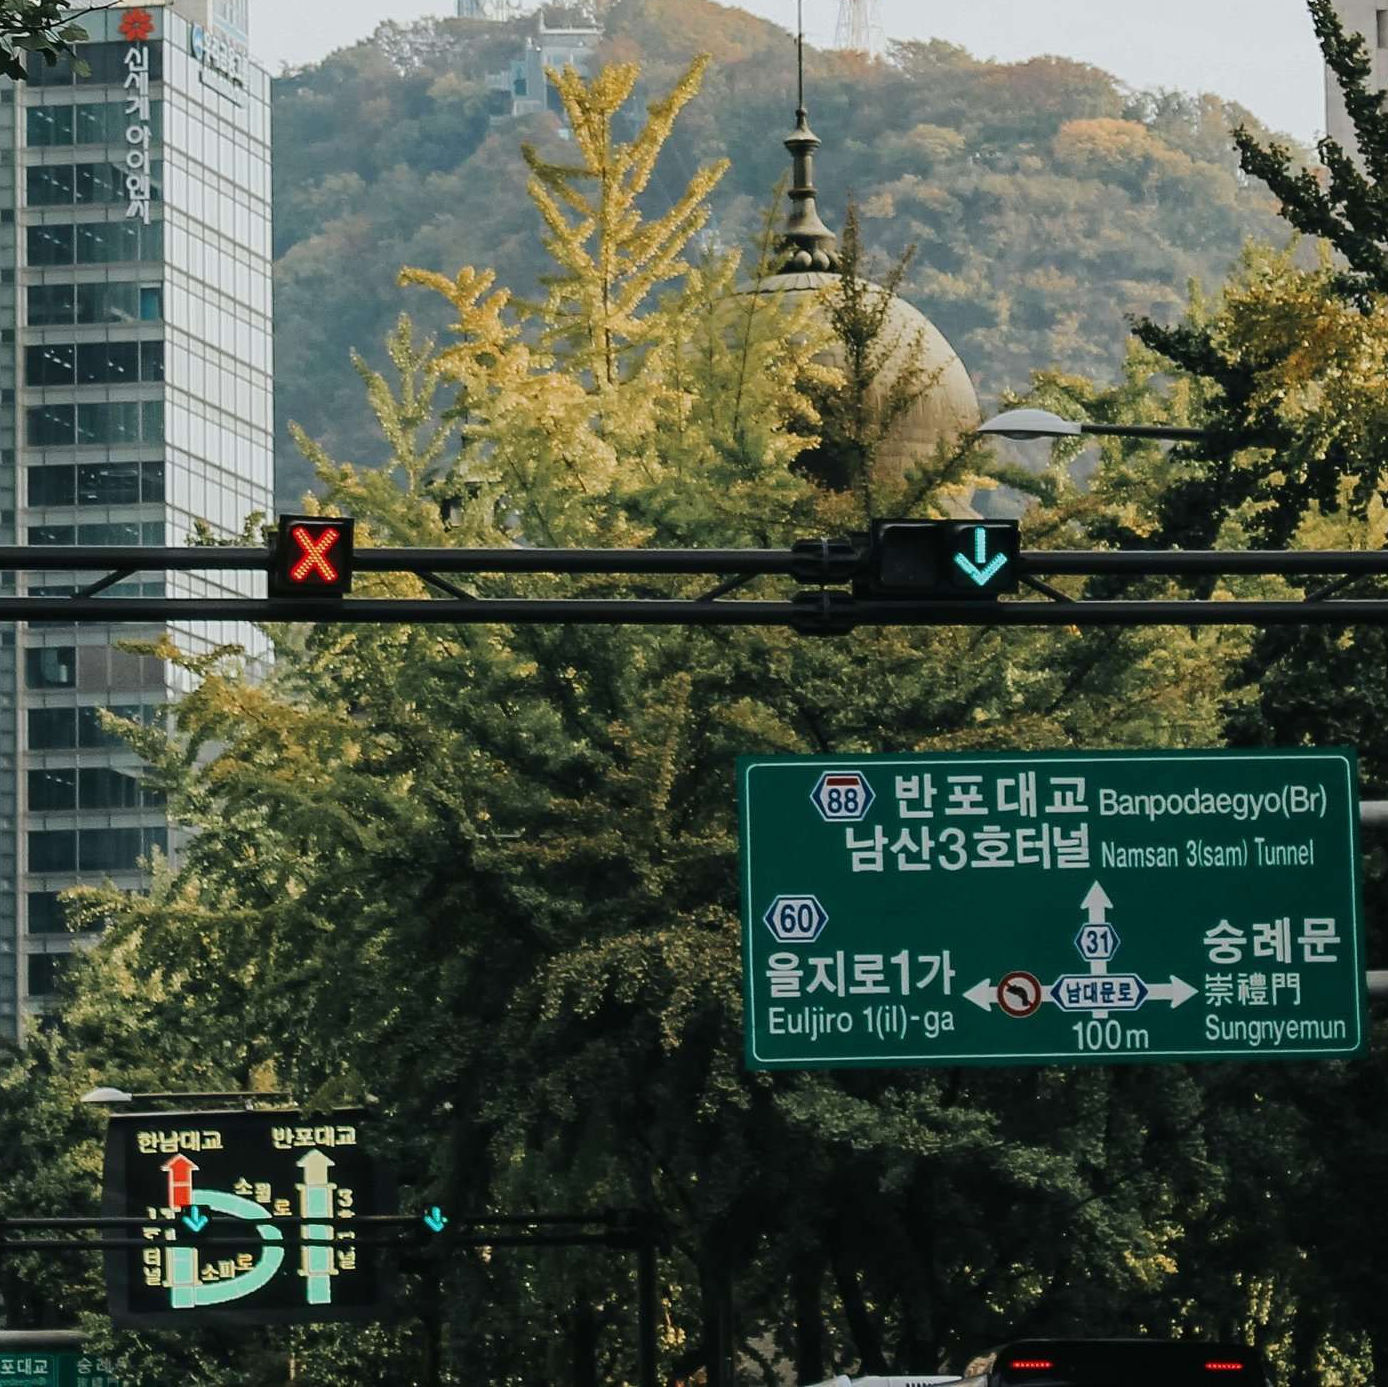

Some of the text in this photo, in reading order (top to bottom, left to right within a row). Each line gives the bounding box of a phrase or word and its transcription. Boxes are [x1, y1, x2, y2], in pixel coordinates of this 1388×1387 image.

[826, 785, 859, 814] 88
[894, 770, 1090, 818] 반포대교
[1099, 785, 1327, 822] Banpodaegyo(Br)
[844, 821, 1091, 873] 남산3호터널
[1101, 836, 1315, 869] Namsan 3(sam) Tunnel
[779, 902, 813, 932] 60
[1086, 930, 1109, 954] 31
[1202, 916, 1342, 964] 숭례문
[765, 948, 956, 999] 을지로1가
[1204, 971, 1302, 1007] 崇禮門
[1066, 981, 1134, 1004] 남대문로
[768, 1004, 956, 1041] Euljiro 1(il)-ga
[1205, 1013, 1347, 1047] Sungnyemun
[137, 1130, 224, 1154] 한남대교
[271, 1125, 357, 1149] 반포대교
[201, 1253, 254, 1281] 소파로
